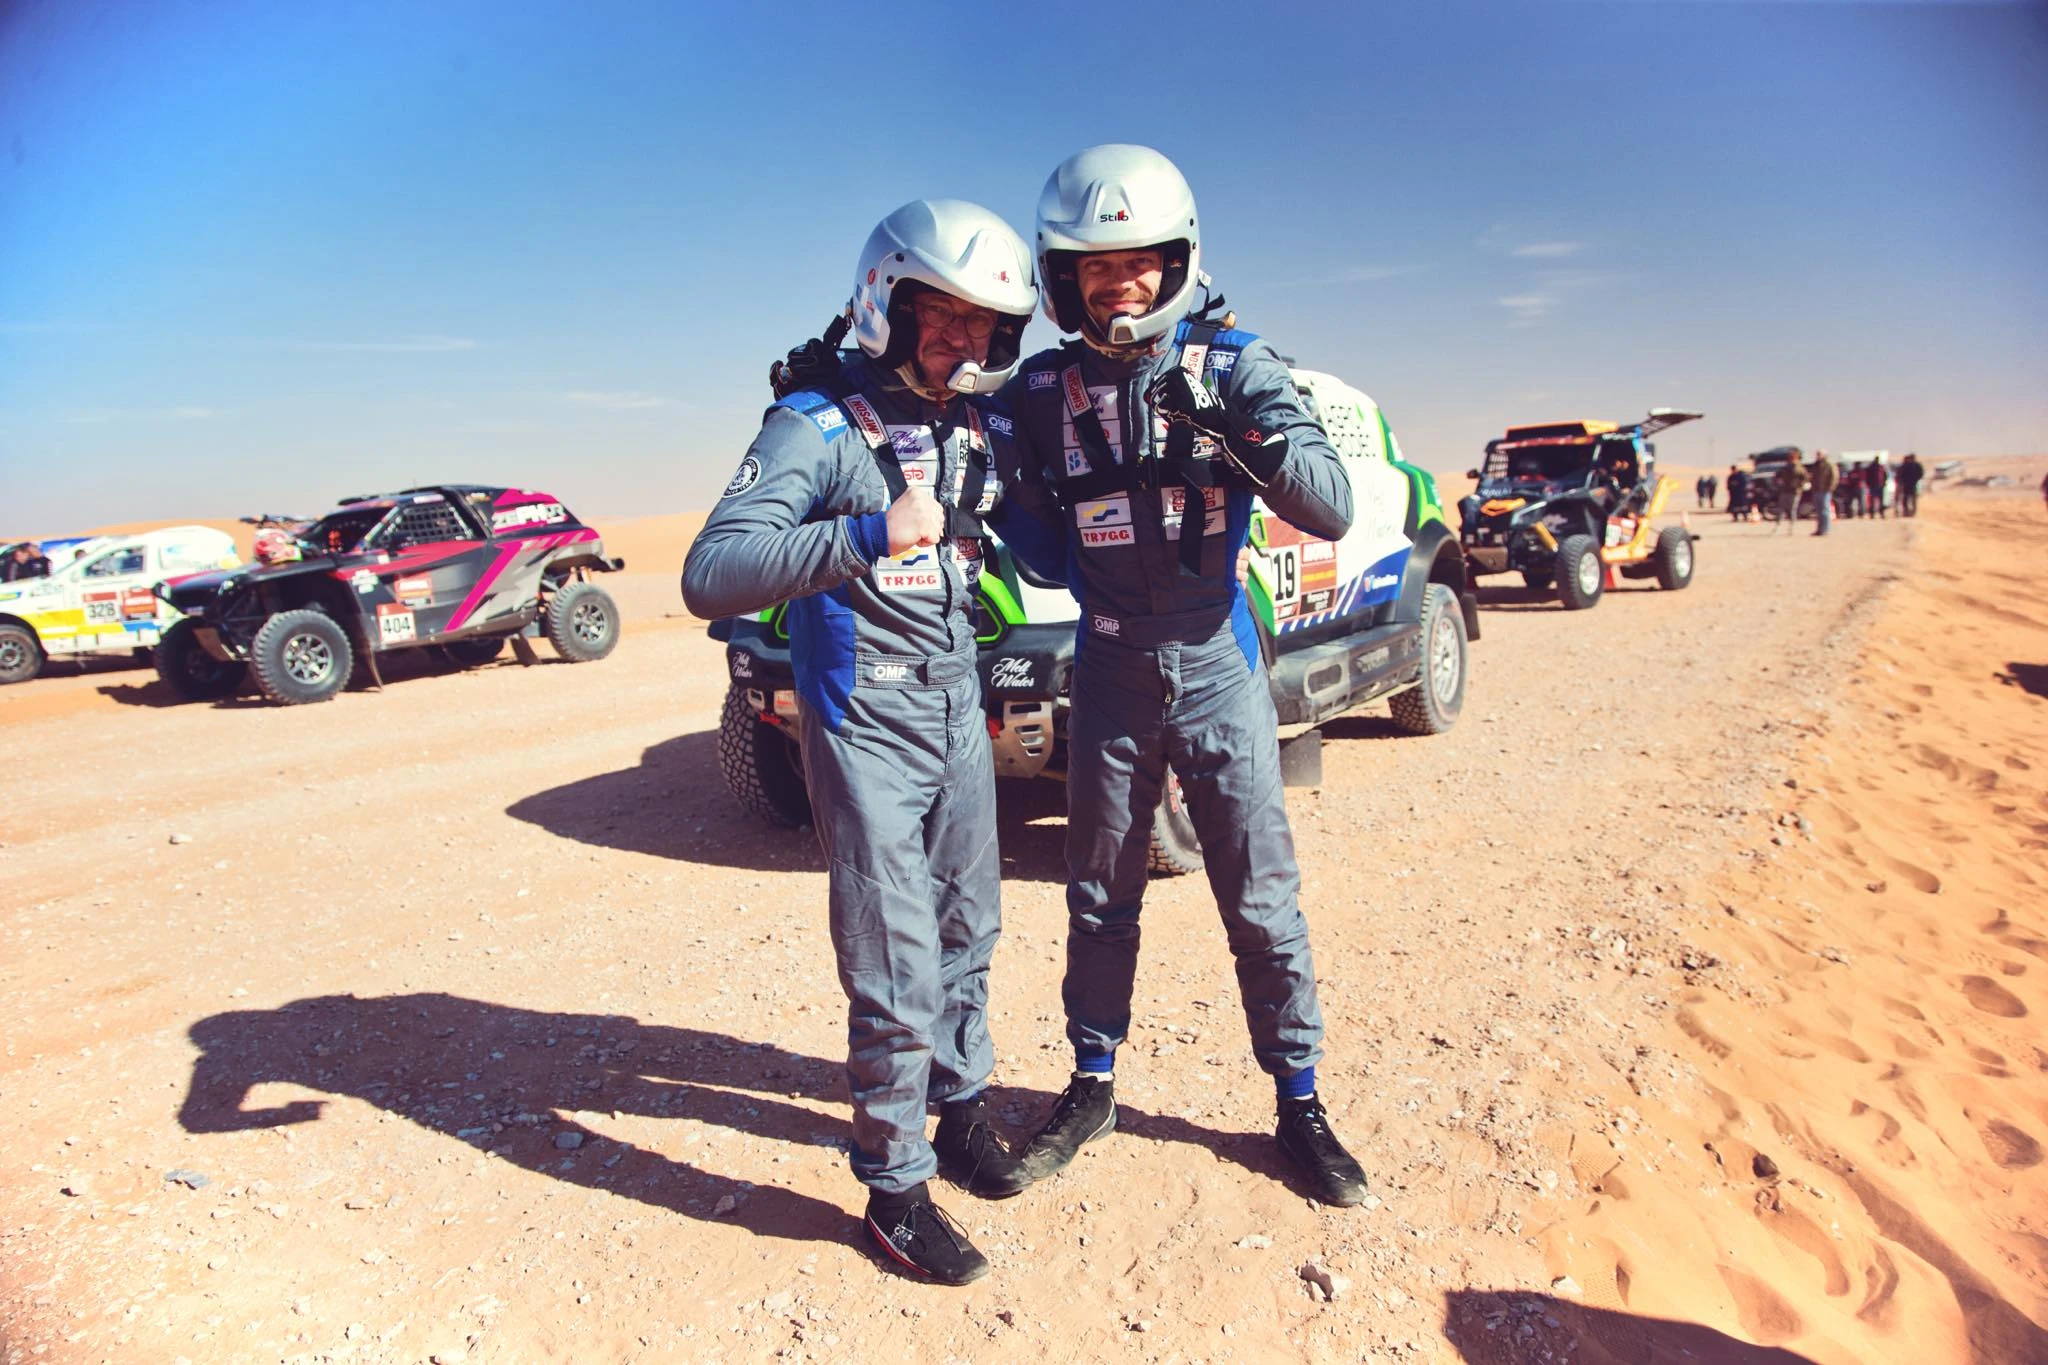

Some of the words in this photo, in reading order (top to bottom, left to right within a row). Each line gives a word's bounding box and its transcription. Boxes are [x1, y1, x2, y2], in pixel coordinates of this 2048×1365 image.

[1099, 210, 1129, 223] Stilo
[1206, 354, 1235, 368] OMP
[1028, 373, 1056, 388] OMP
[816, 407, 847, 430] OMP
[850, 399, 884, 441] SIMPSON
[988, 415, 1013, 432] OMP
[1083, 529, 1130, 543] TRYGG
[883, 575, 936, 586] TRYGG
[86, 602, 116, 618] 328
[382, 616, 411, 633] 404
[1095, 618, 1120, 633] OMP
[874, 665, 907, 679] OMP
